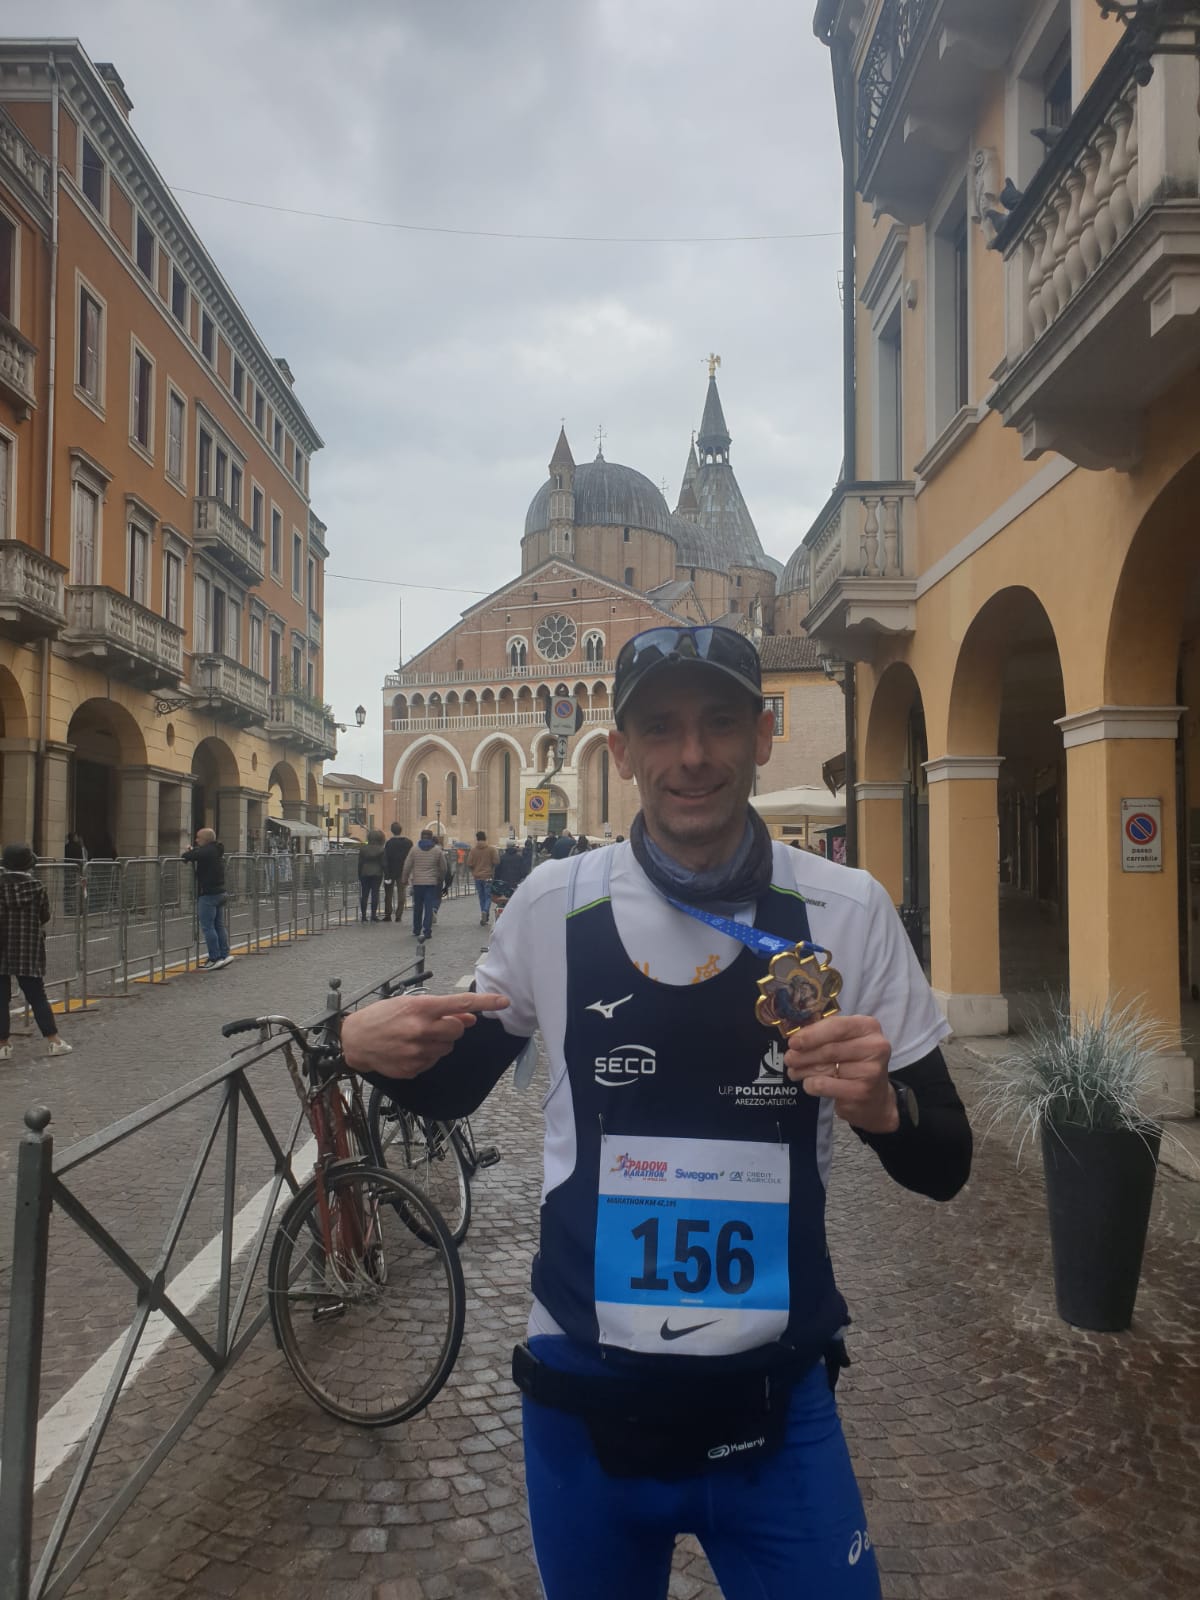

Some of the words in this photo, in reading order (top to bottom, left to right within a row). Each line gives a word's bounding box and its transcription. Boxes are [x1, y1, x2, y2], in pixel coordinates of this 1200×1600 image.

[594, 1057, 656, 1073] SECO
[735, 1086, 798, 1096] POLICIANO
[628, 1160, 668, 1171] PADOVA
[623, 1169, 665, 1178] MARATHON
[675, 1168, 719, 1182] Swegon
[607, 1197, 644, 1206] MARATHON
[631, 1217, 755, 1295] 156
